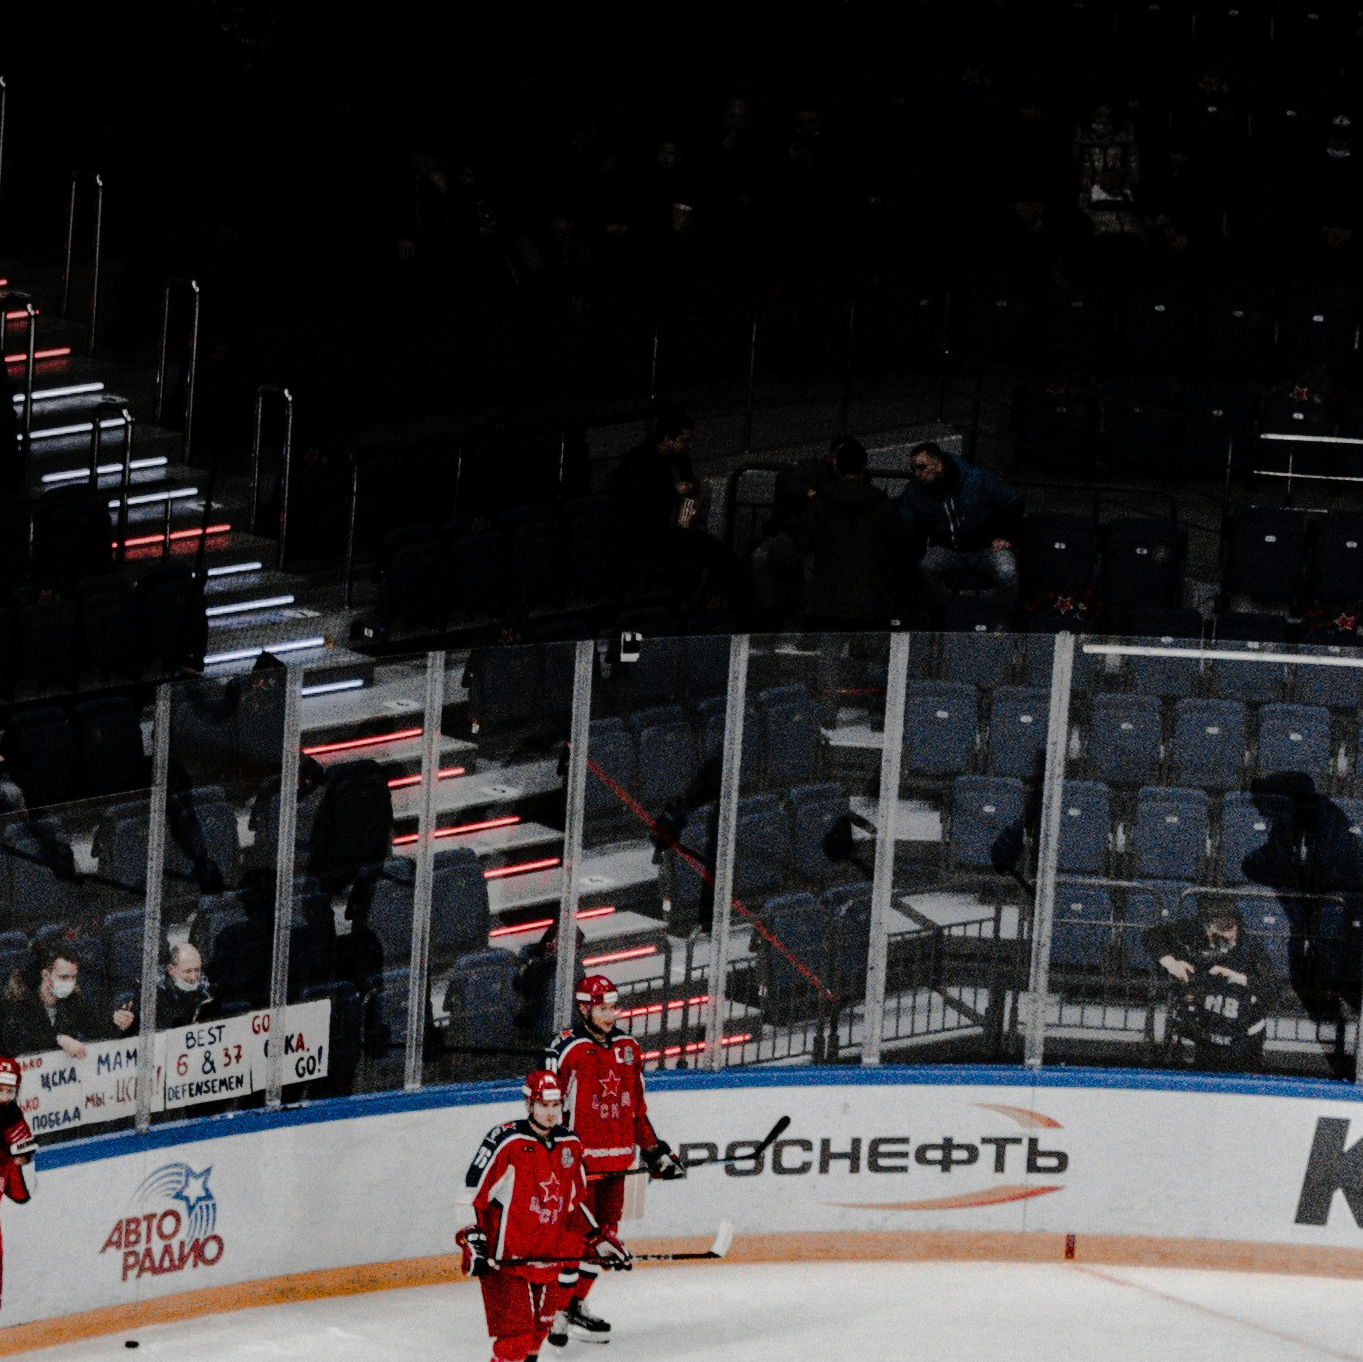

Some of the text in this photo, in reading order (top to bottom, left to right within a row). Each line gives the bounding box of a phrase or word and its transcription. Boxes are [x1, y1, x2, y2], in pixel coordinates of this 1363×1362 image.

[185, 1025, 226, 1049] BEST
[251, 1013, 271, 1036] GO
[177, 1044, 243, 1077] 6 & 37
[294, 1045, 324, 1079] GO!
[167, 1074, 244, 1102] DEFENSEMEN
[32, 1106, 81, 1133] ПОБЕДА
[678, 1134, 1070, 1177] РОСНЕФТЬ
[98, 1208, 182, 1254] АВТО
[121, 1233, 225, 1283] РАДИО
